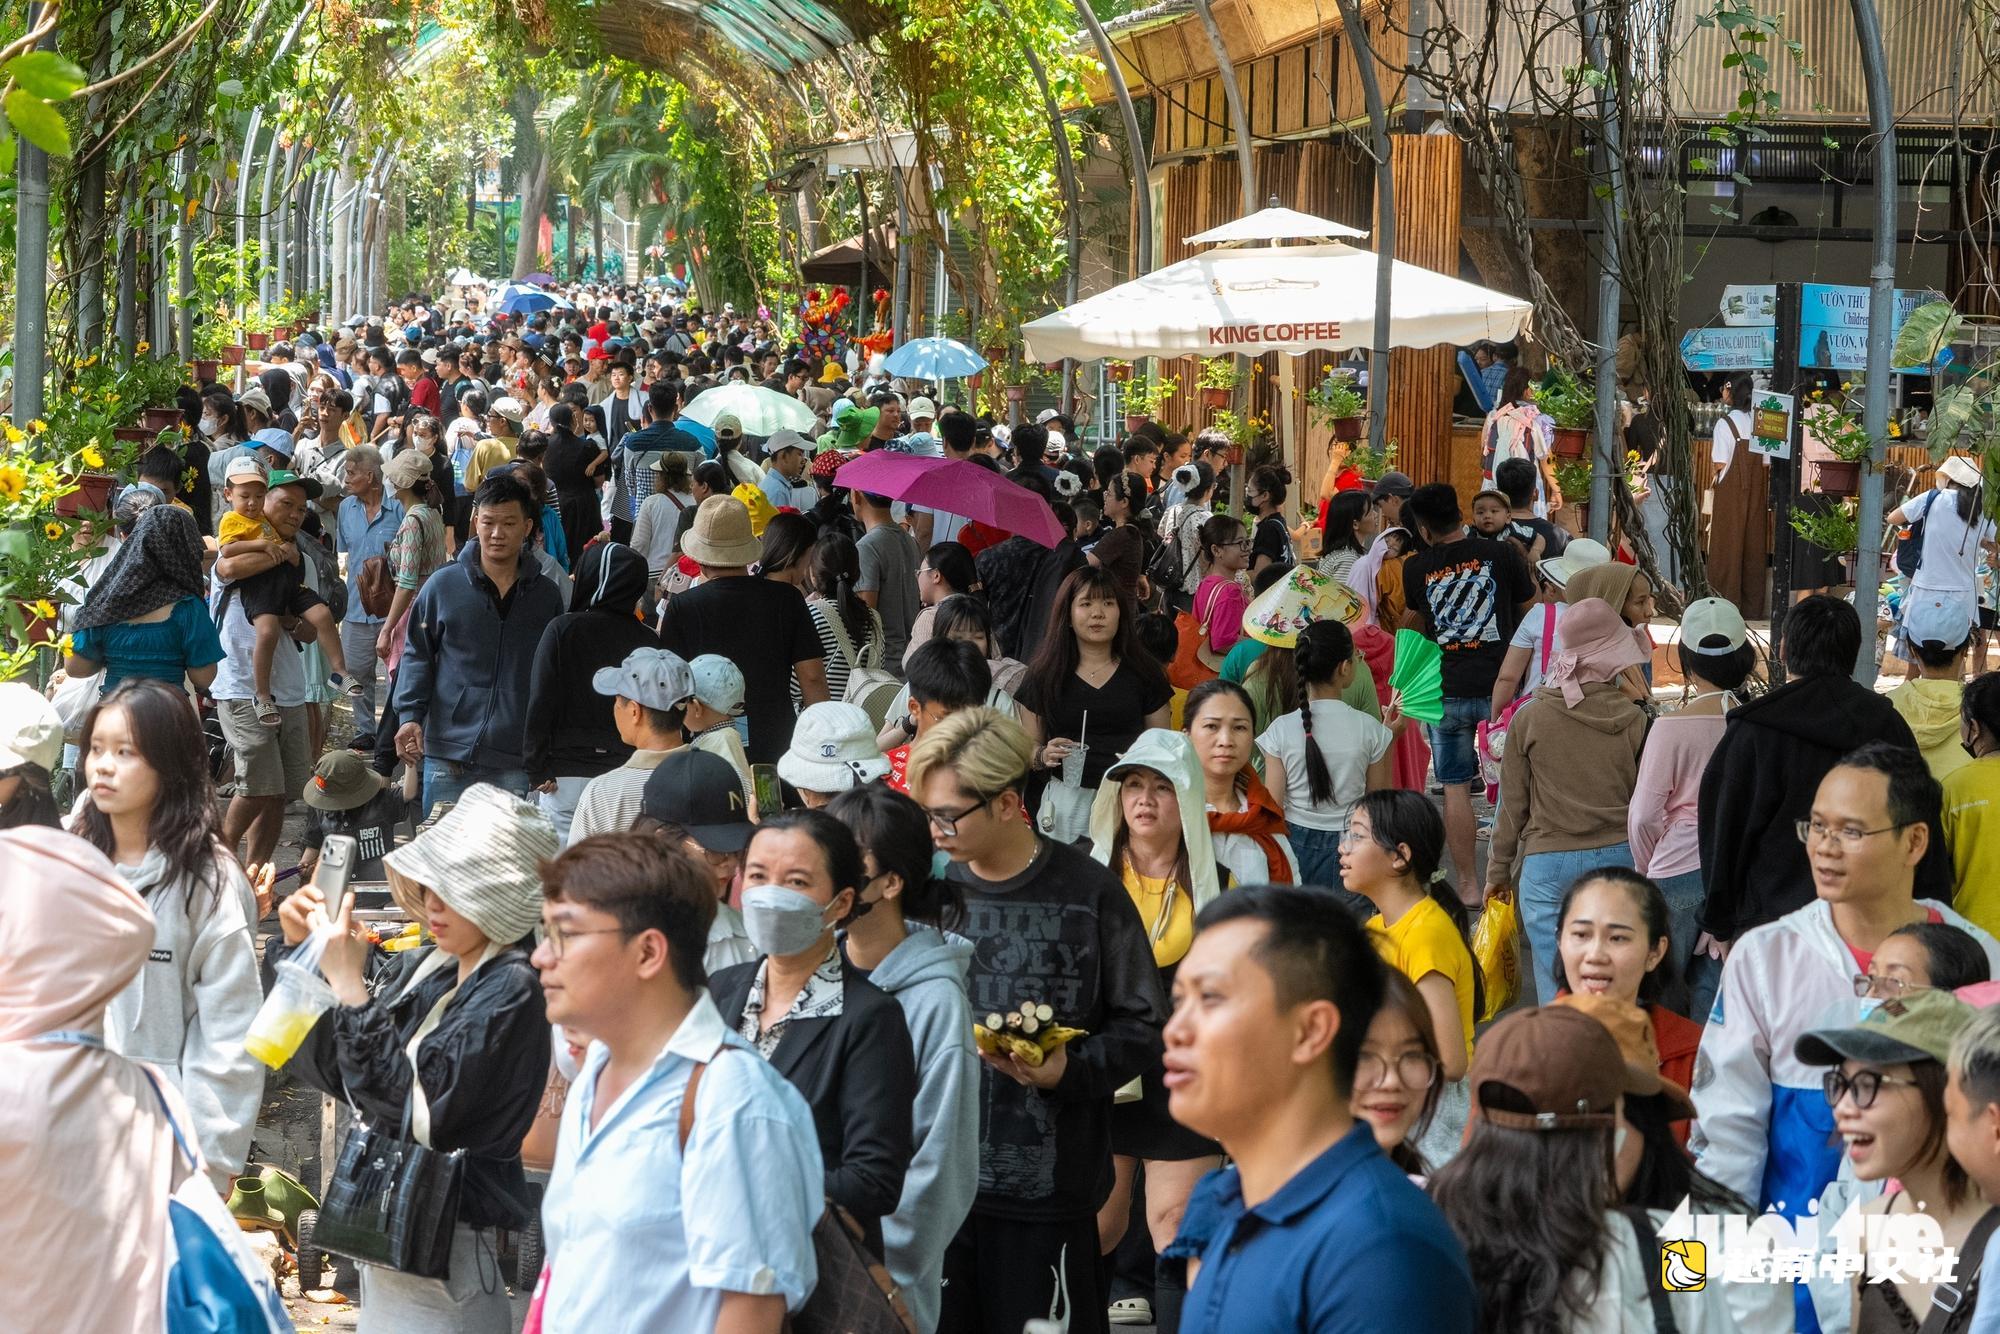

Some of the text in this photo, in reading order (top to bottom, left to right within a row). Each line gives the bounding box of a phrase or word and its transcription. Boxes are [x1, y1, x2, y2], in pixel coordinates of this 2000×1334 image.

[1820, 291, 1866, 309] VƯỜN THÚ
[1209, 322, 1340, 344] KING COFFEE
[360, 826, 380, 841] 1997
